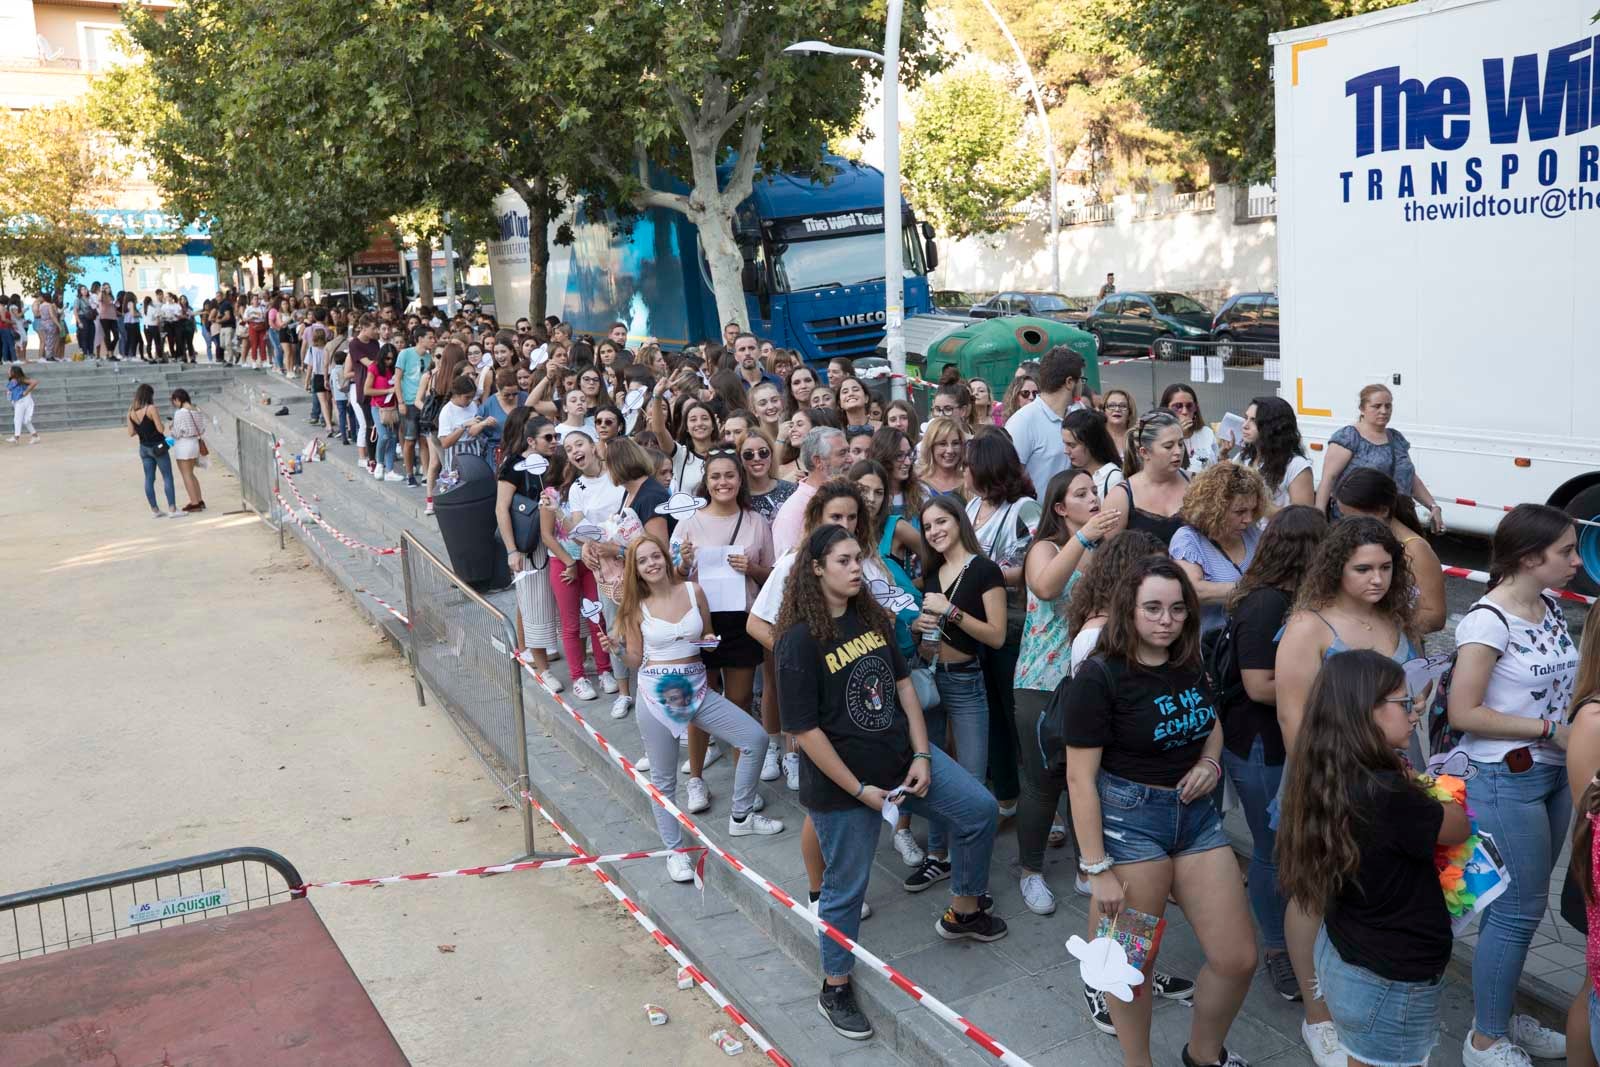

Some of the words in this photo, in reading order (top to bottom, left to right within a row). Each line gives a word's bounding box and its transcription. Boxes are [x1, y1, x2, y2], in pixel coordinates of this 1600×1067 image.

[1345, 66, 1471, 158] The
[1340, 145, 1600, 203] TRANSPOR
[802, 217, 829, 232] The
[827, 213, 856, 230] Wild
[855, 212, 883, 226] Tour
[840, 311, 886, 327] IVECO
[1530, 664, 1555, 677] Take
[1154, 695, 1177, 715] TE
[140, 903, 151, 912] AS
